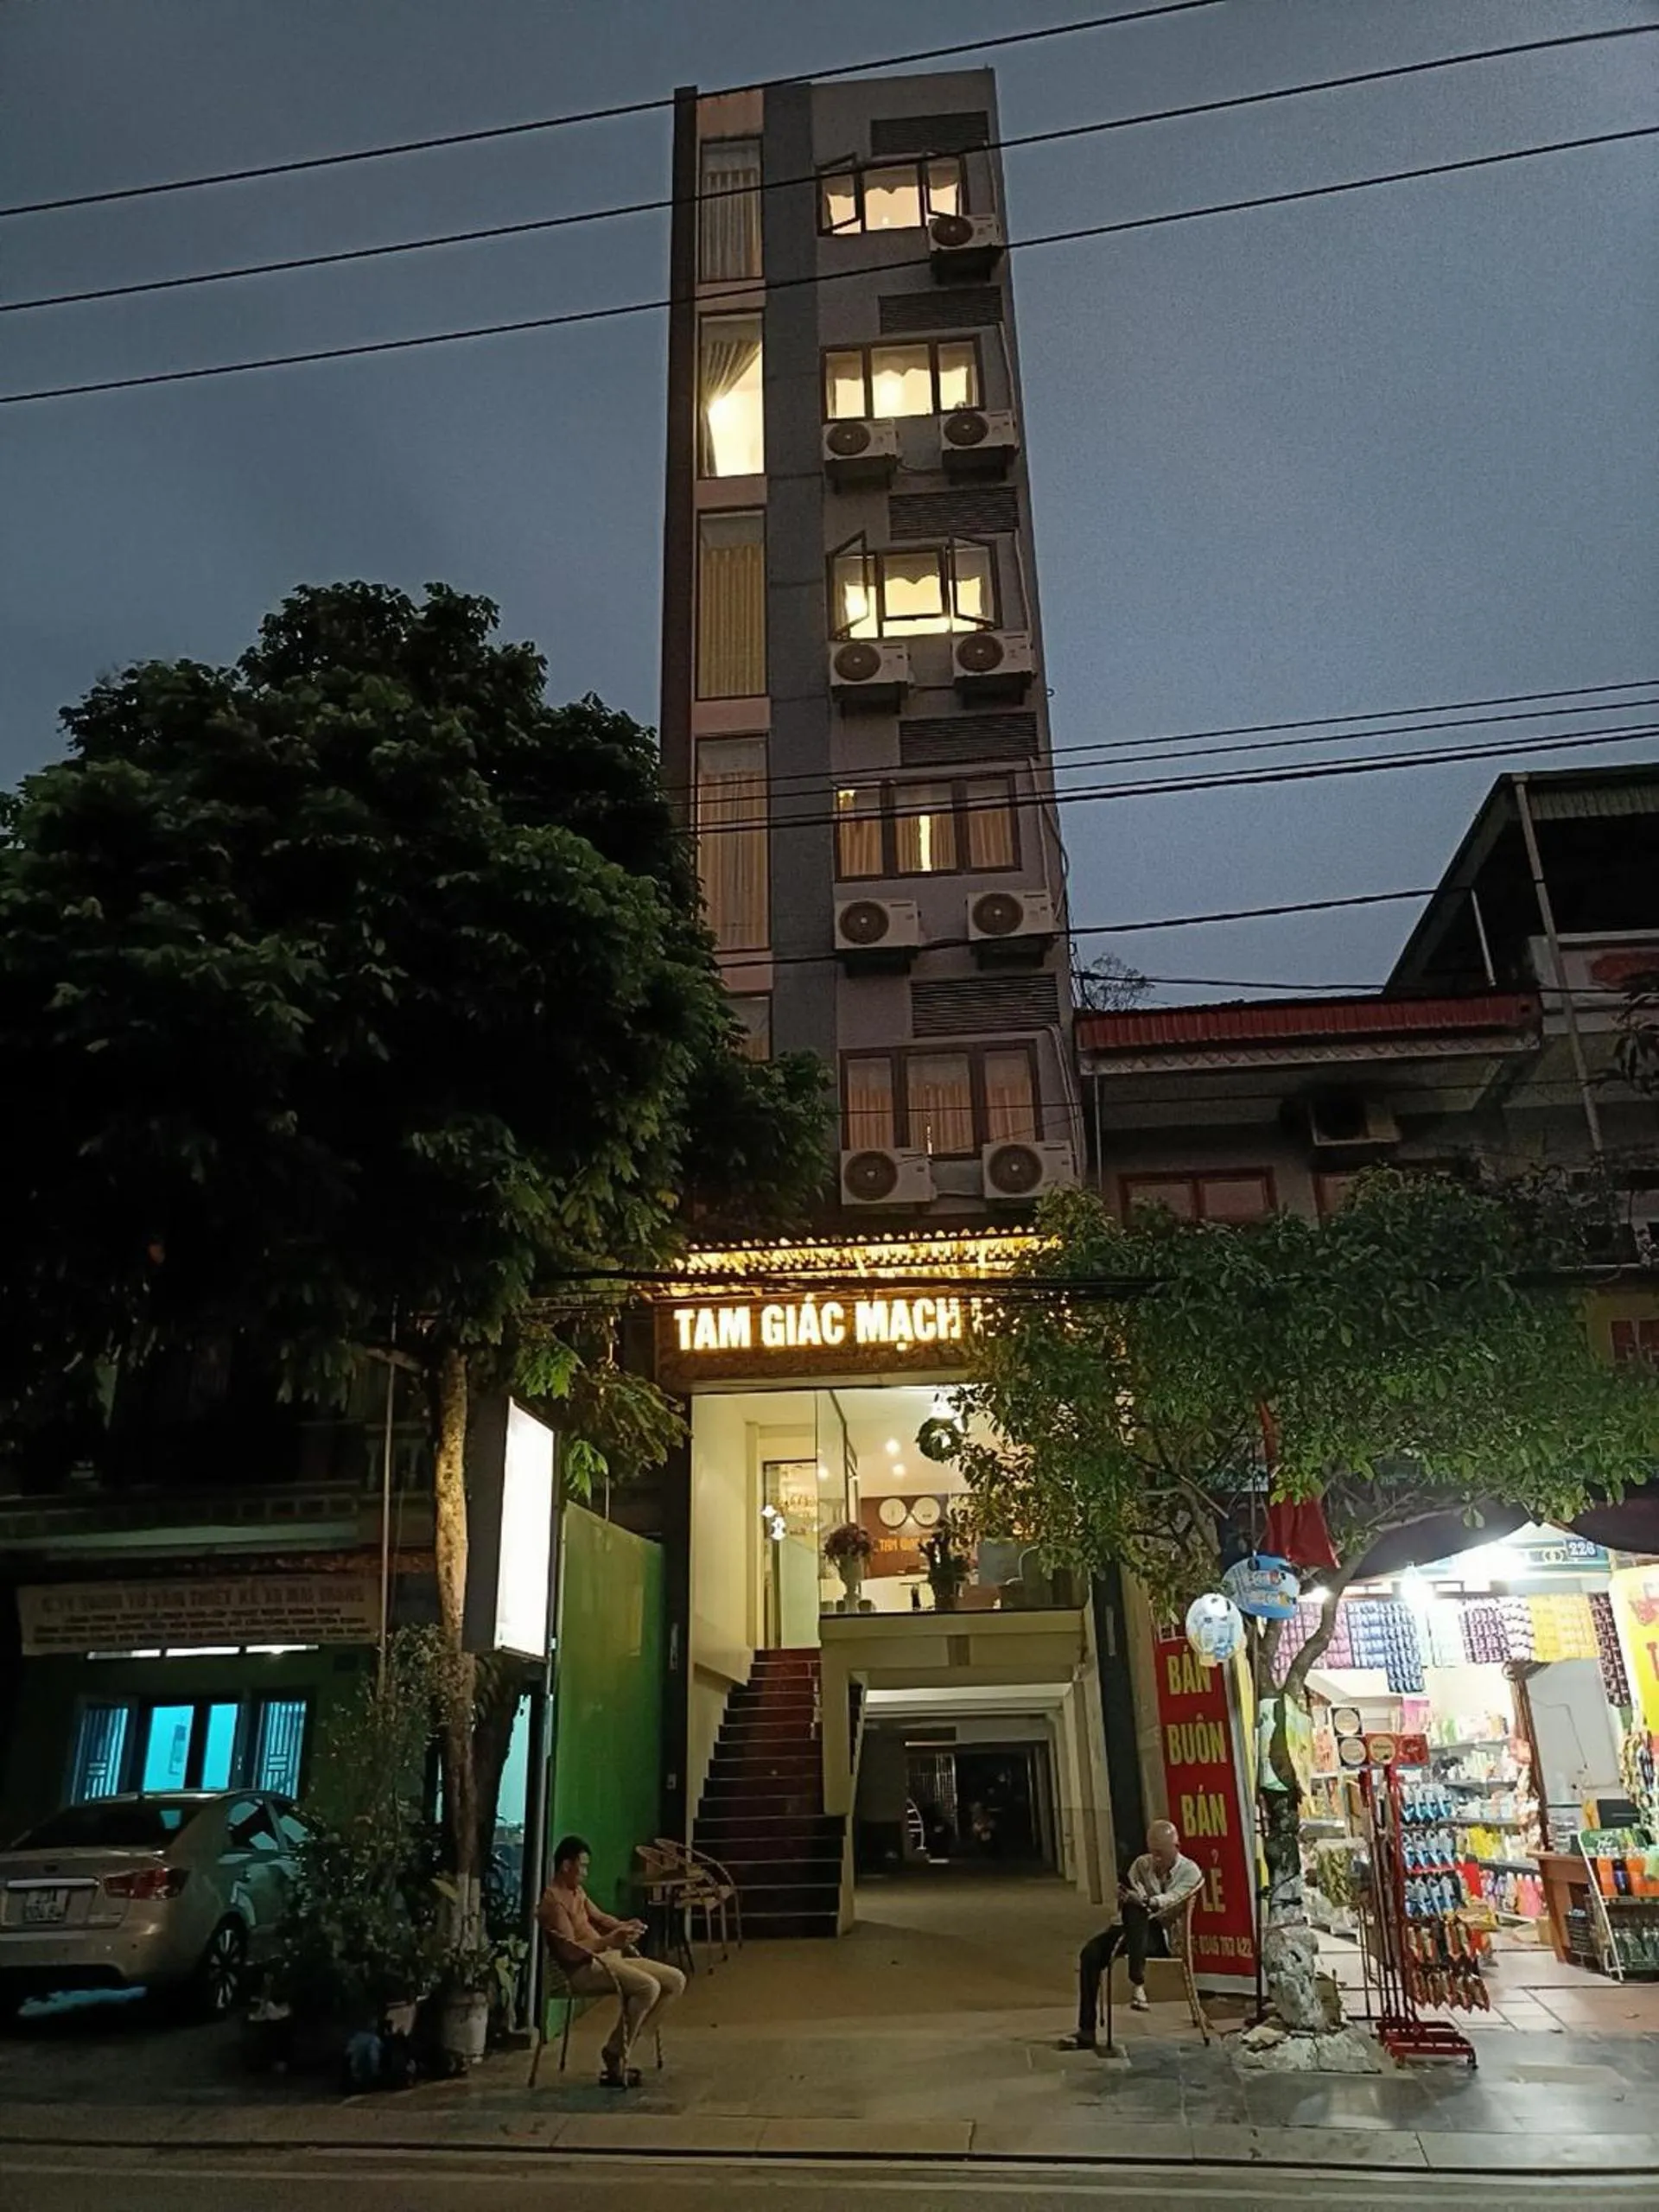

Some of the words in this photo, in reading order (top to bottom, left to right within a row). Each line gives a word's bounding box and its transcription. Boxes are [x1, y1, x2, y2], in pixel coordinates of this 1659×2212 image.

[673, 1305, 751, 1351] TAM
[760, 1292, 845, 1348] GIÁC
[855, 1296, 962, 1352] MẠCH
[1567, 1541, 1597, 1556] 226
[1166, 1644, 1212, 1695] BÁN
[1166, 1712, 1228, 1765] BUÔN
[1180, 1784, 1228, 1838] BÁN
